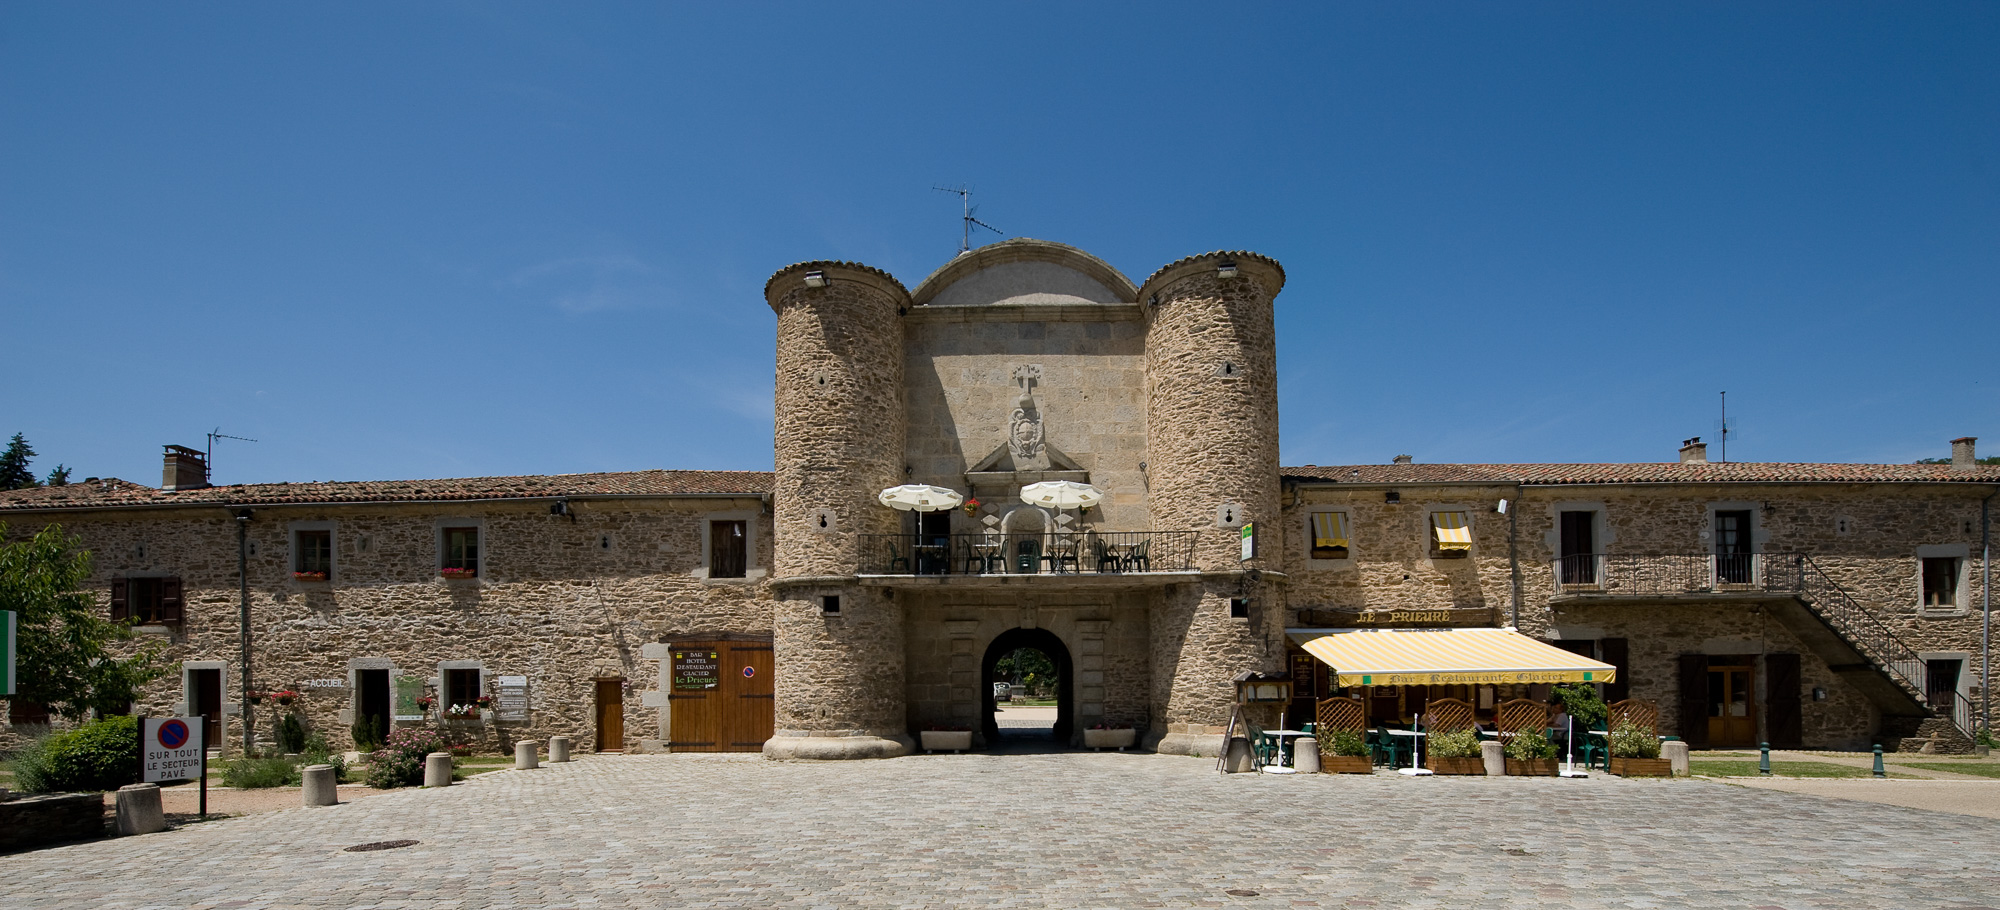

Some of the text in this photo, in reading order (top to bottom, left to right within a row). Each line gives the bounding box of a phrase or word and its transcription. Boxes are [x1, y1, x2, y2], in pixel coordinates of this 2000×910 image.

[1357, 610, 1450, 623] LE PRIEURÉ
[310, 678, 345, 688] ACCUEIL
[675, 676, 718, 684] Le Prieuré
[1390, 672, 1565, 683] Bar Restaurant Glacier
[149, 749, 198, 760] SUR TOUT
[147, 759, 199, 771] LE SECTEUR
[161, 768, 186, 779] PAVÉ
